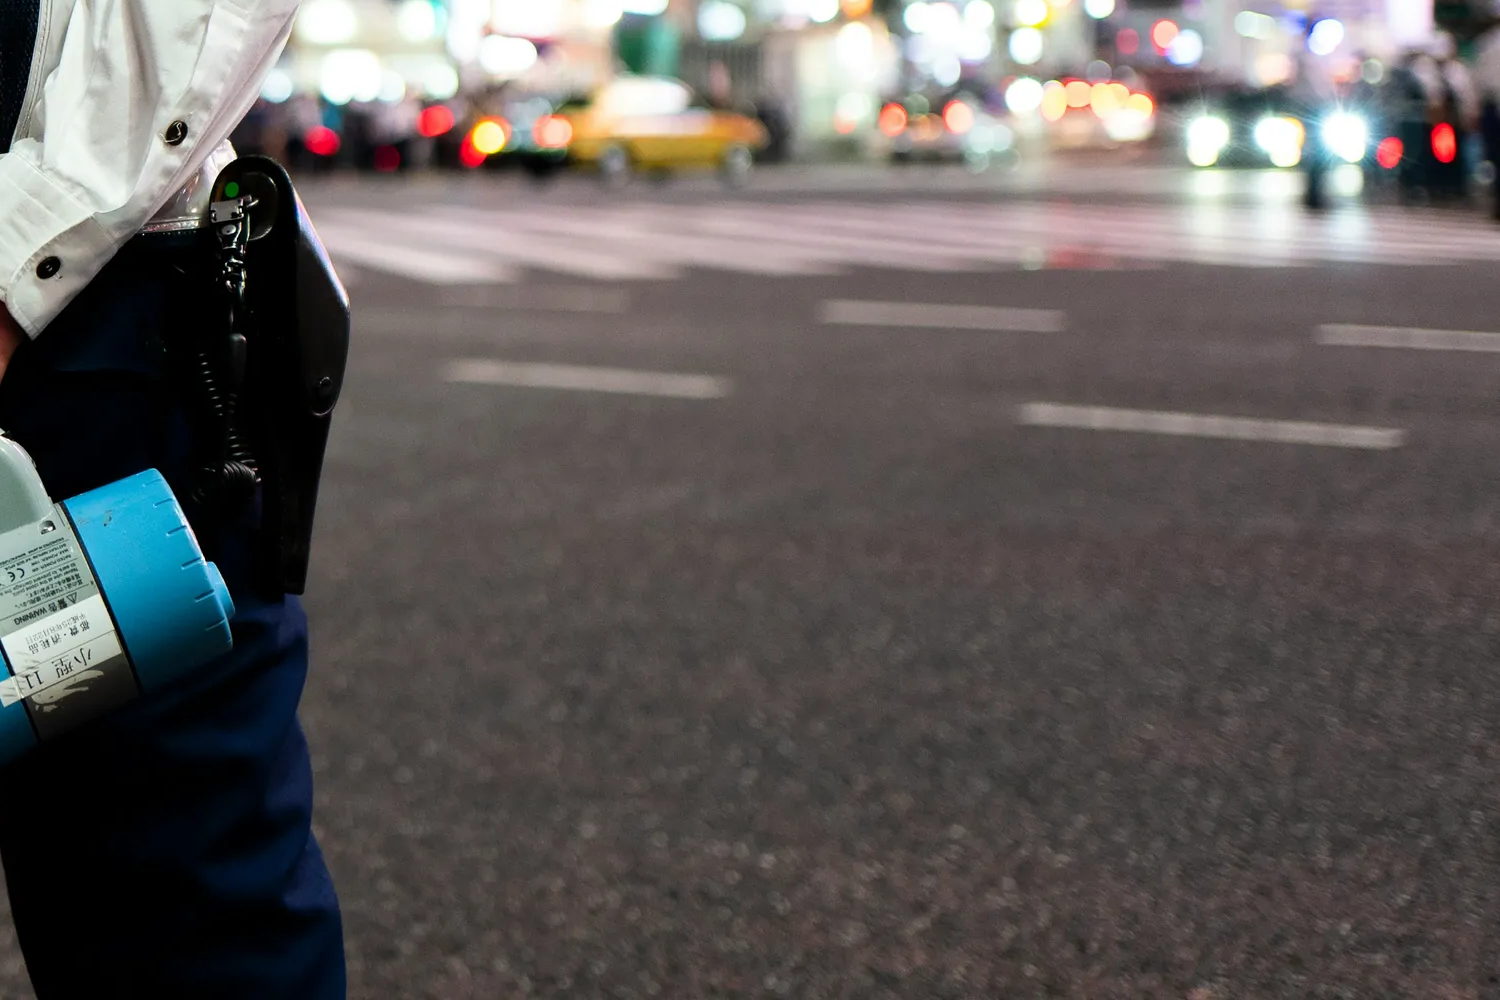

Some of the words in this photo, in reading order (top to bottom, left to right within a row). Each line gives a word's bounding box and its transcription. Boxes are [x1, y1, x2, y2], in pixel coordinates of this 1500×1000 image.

[32, 571, 51, 582] prevent
[46, 597, 67, 613] 警告
[13, 606, 47, 625] WARNING
[50, 644, 94, 678] 小型
